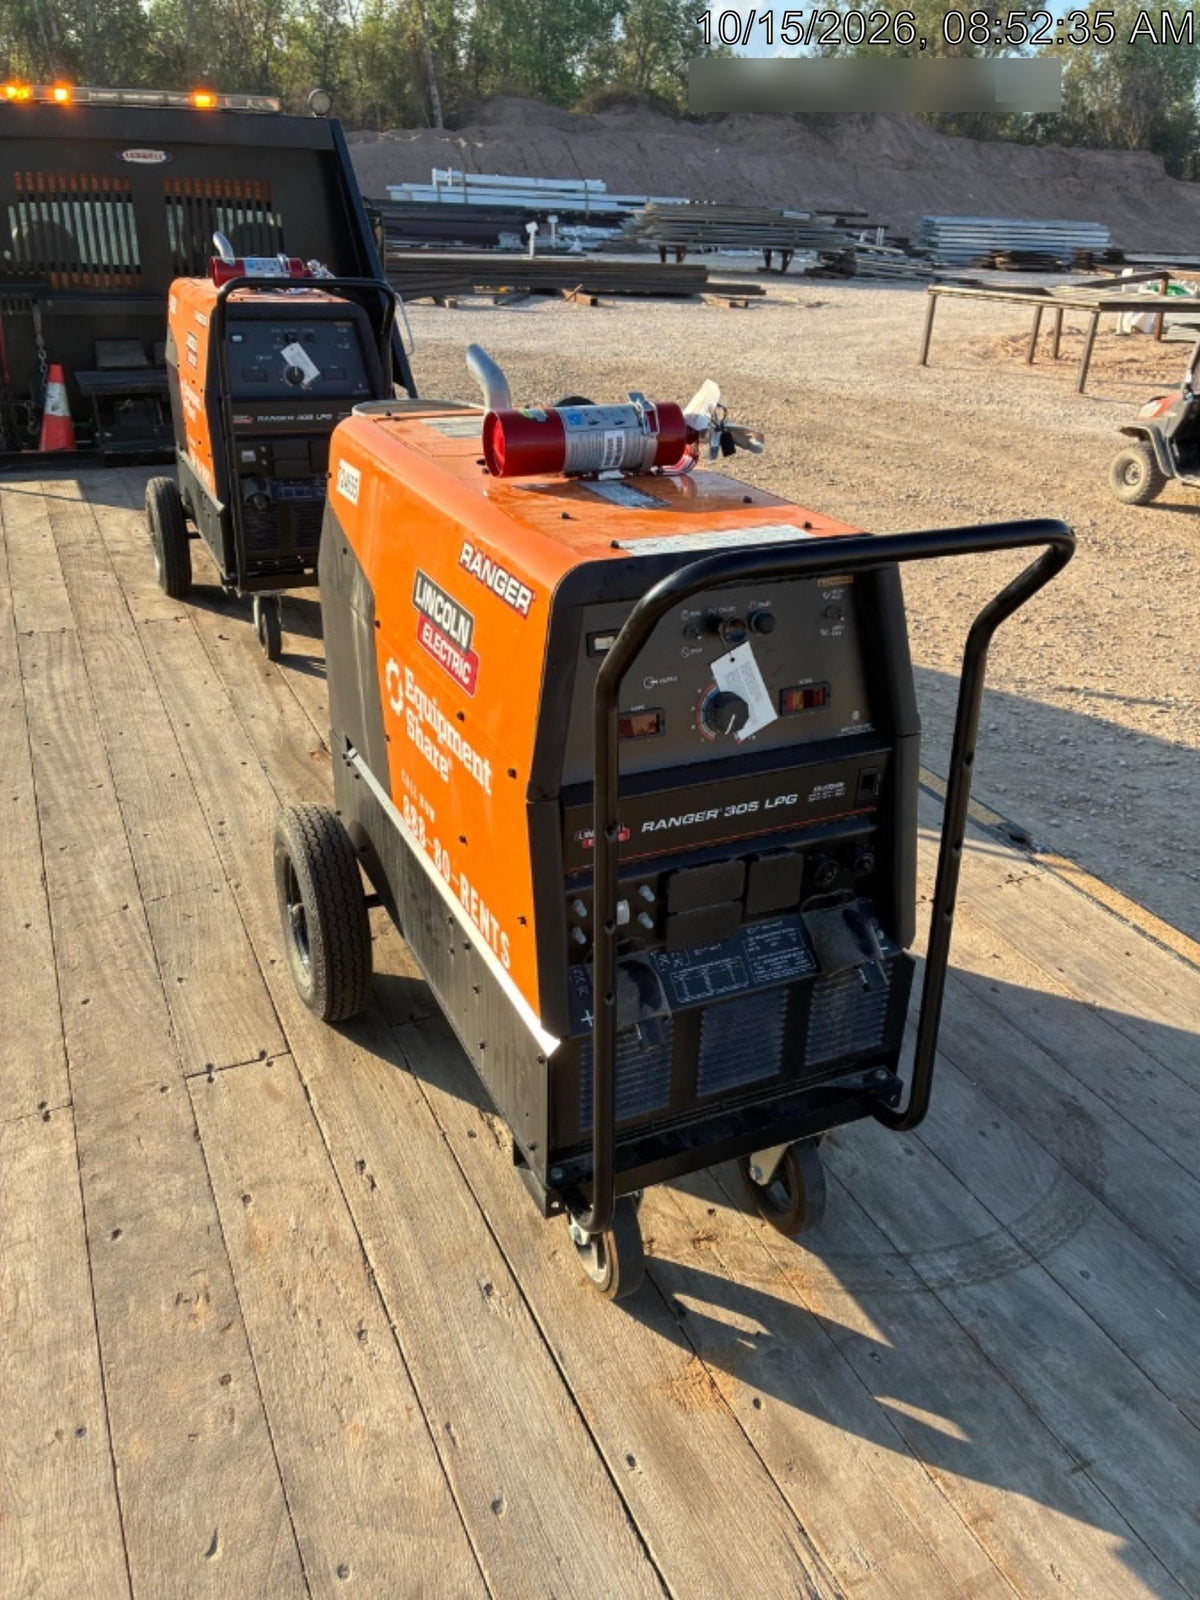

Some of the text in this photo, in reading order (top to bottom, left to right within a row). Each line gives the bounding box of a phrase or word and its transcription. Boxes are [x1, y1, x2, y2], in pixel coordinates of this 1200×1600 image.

[415, 576, 471, 649] LINCOLN
[459, 541, 532, 615] RANGER
[422, 622, 471, 685] ELECTRIC
[405, 666, 492, 797] Equipment
[406, 707, 450, 784] Share
[641, 808, 720, 833] RANGER
[723, 800, 760, 818] 305
[764, 793, 799, 809] LPG
